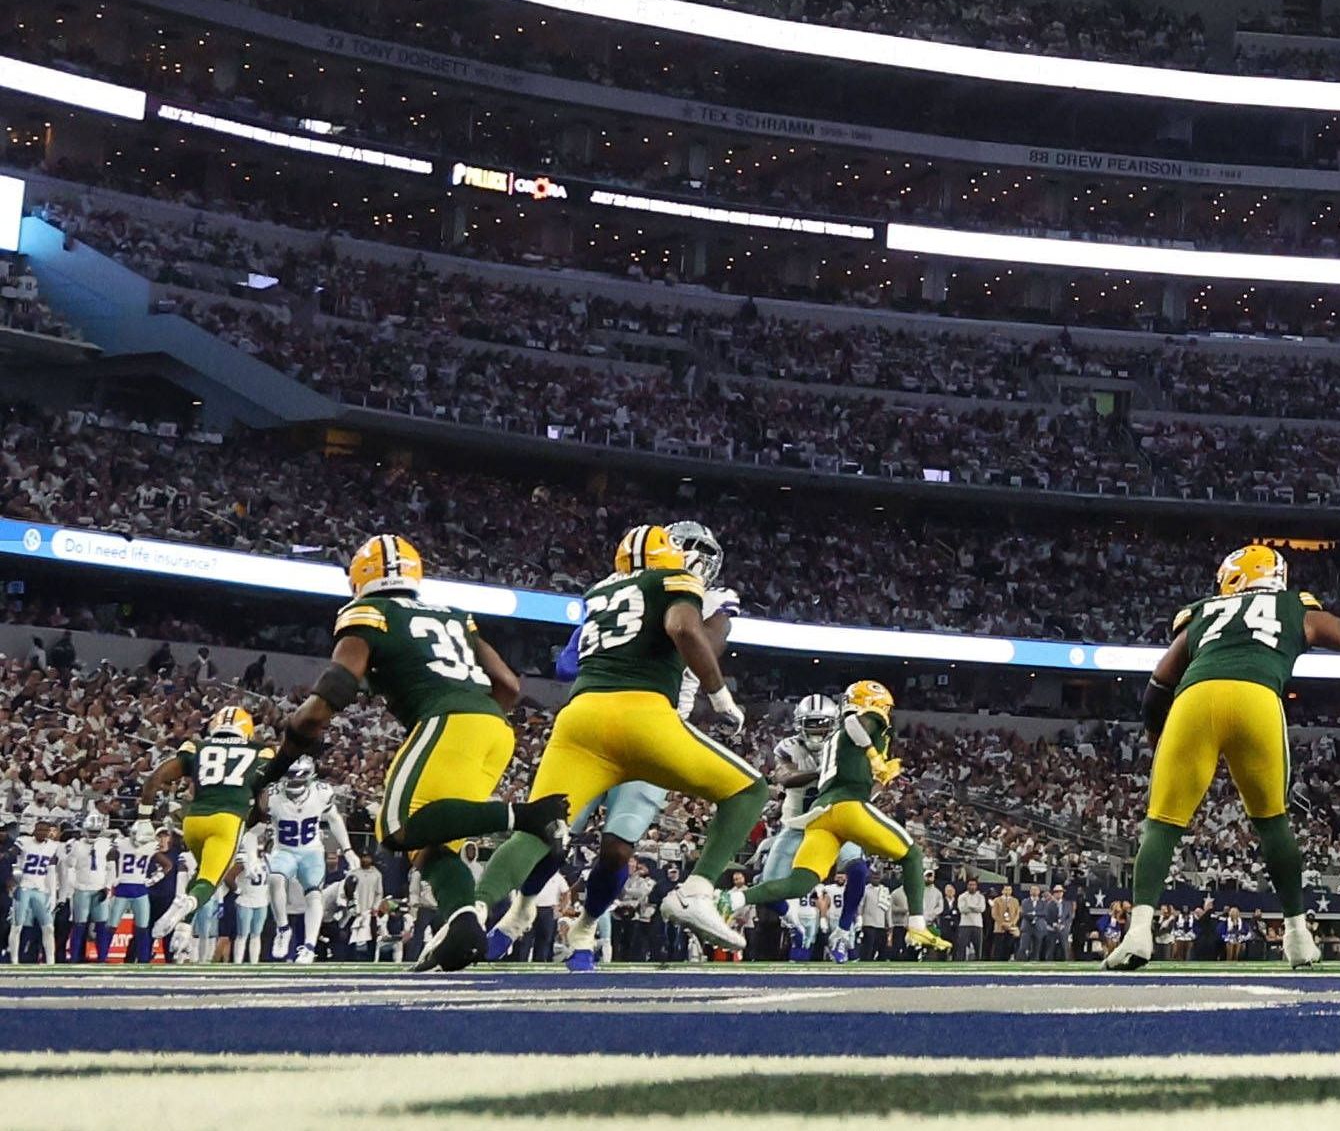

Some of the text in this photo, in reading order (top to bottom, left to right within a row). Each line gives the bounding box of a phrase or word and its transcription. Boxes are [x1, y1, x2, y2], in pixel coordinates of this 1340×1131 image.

[735, 112, 816, 135] SCHRAMM
[1055, 152, 1103, 169] DREW
[1107, 156, 1183, 177] PEARSON
[64, 538, 83, 554] Do
[95, 543, 127, 560] need
[131, 546, 150, 563] life
[154, 550, 218, 571] insurance?
[1198, 594, 1282, 649] 74
[409, 615, 492, 686] 31
[198, 746, 257, 787] 87
[278, 817, 319, 848] 26
[22, 853, 50, 876] 25
[89, 848, 98, 872] 1
[122, 853, 149, 875] 24
